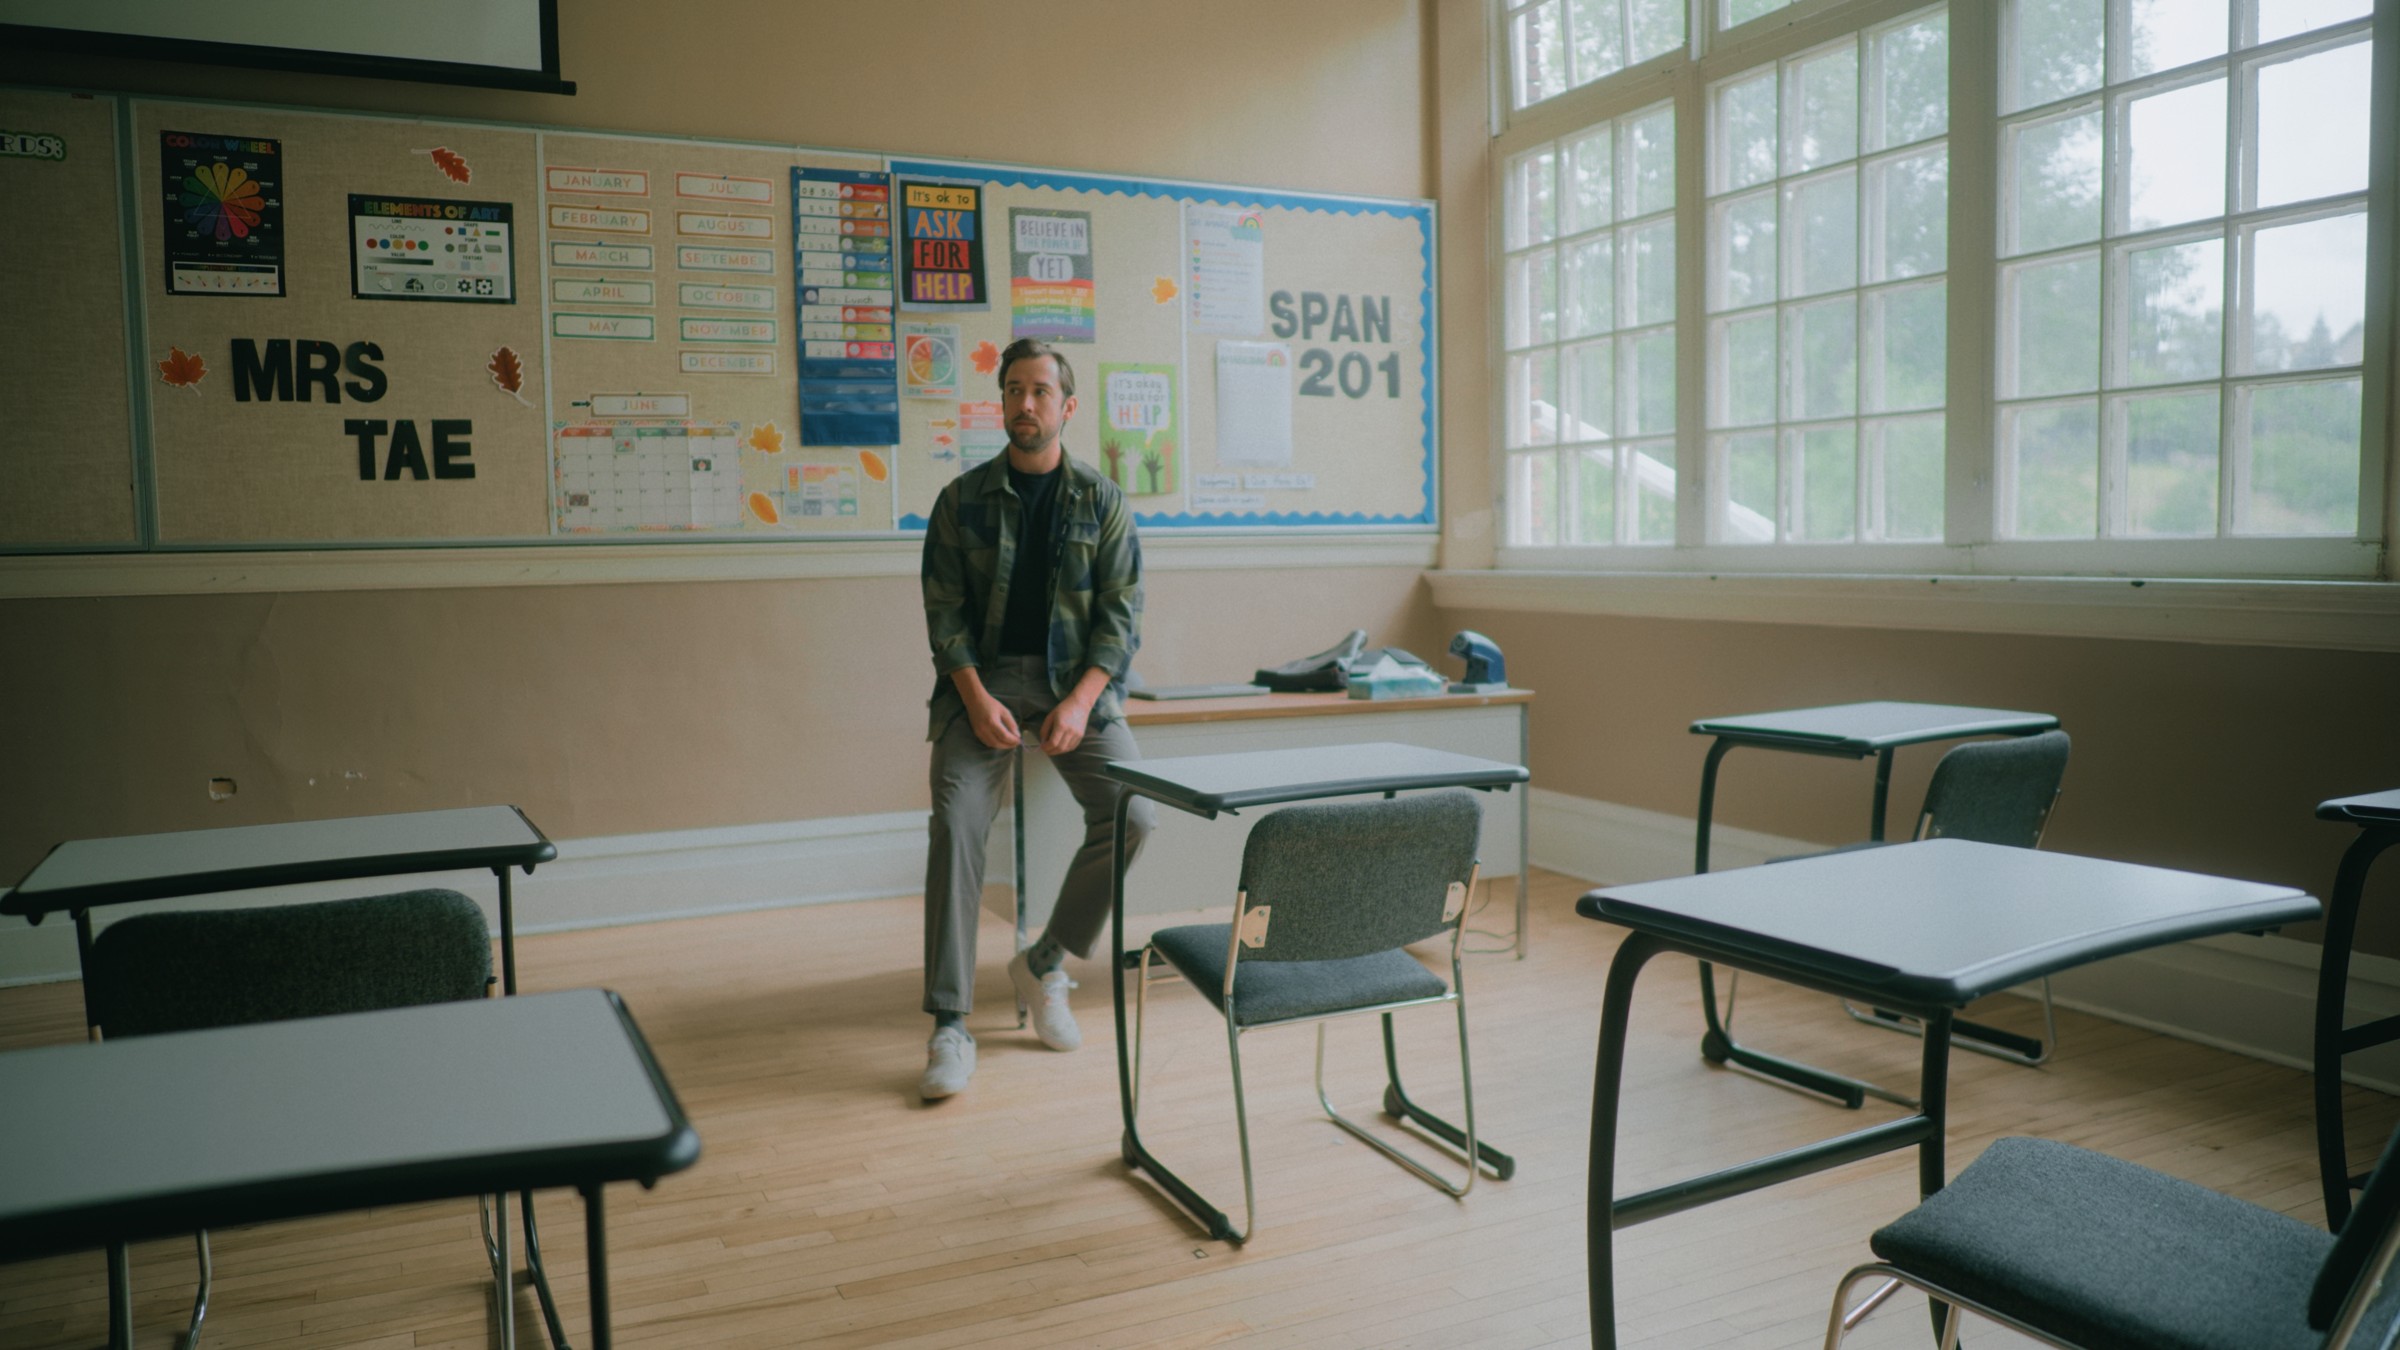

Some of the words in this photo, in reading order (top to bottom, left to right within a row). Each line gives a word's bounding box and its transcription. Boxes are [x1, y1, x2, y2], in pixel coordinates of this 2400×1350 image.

[166, 134, 220, 149] COLOR
[224, 139, 275, 155] WHEEL
[563, 175, 631, 188] JANUARY
[708, 182, 742, 194] JULY
[364, 201, 441, 218] ELEMENTS
[444, 205, 467, 219] OF
[470, 207, 500, 221] ART
[562, 211, 639, 226] FEBRUARY
[697, 219, 752, 232] AUGUST
[914, 210, 963, 239] ASK
[1020, 220, 1067, 238] BELIEVE
[1070, 223, 1084, 238] IN
[1023, 238, 1039, 248] THE
[1041, 239, 1069, 249] POWER
[1072, 240, 1083, 250] OF
[575, 250, 629, 262] MARCH
[684, 252, 766, 266] SEPTEMBER
[920, 241, 963, 268] FOR
[1036, 257, 1065, 279] YET
[582, 287, 625, 298] APRIL
[915, 273, 972, 300] HELP
[692, 290, 761, 303] OCTOBER
[844, 295, 873, 304] Lunch
[1269, 290, 1391, 343] SPAN
[589, 320, 620, 332] MAY
[689, 324, 768, 336] NOVEMBER
[688, 356, 765, 368] DECEMBER
[231, 338, 388, 404] MRS
[1299, 348, 1400, 399] 201
[622, 400, 659, 411] JUNE
[1118, 402, 1161, 426] HELP
[344, 419, 476, 481] TAE
